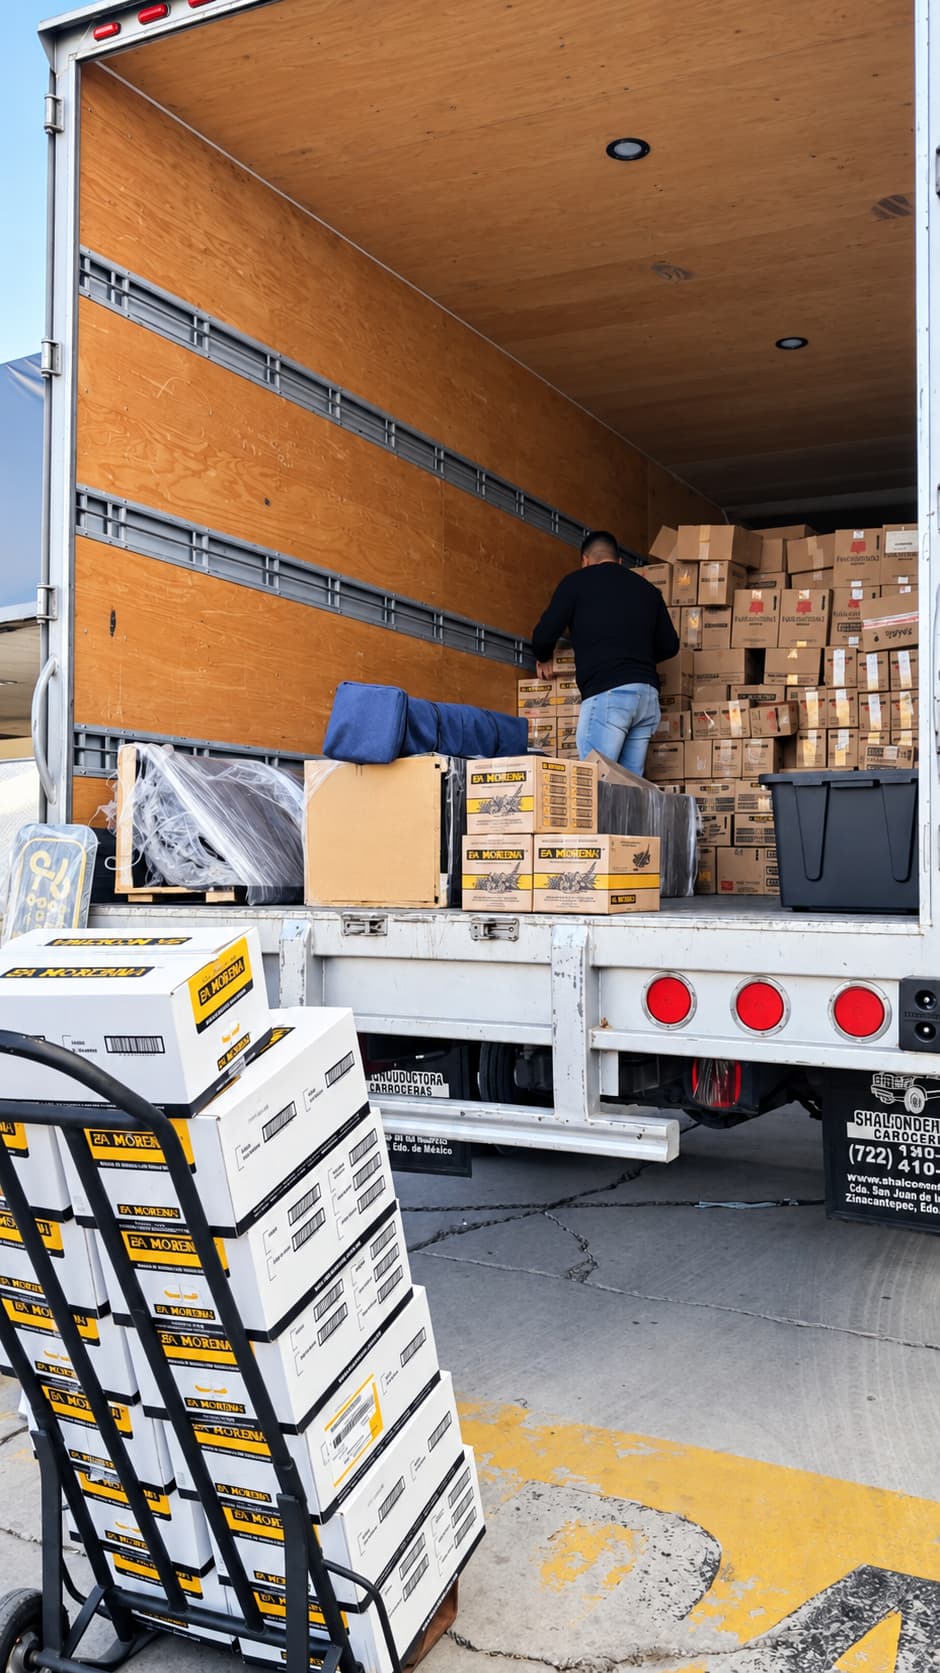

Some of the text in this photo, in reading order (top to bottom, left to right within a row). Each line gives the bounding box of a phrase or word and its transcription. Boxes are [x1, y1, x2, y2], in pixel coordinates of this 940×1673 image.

[849, 1143, 893, 1170] (722)
[893, 1188, 917, 1201] Juan
[919, 1191, 932, 1202] de
